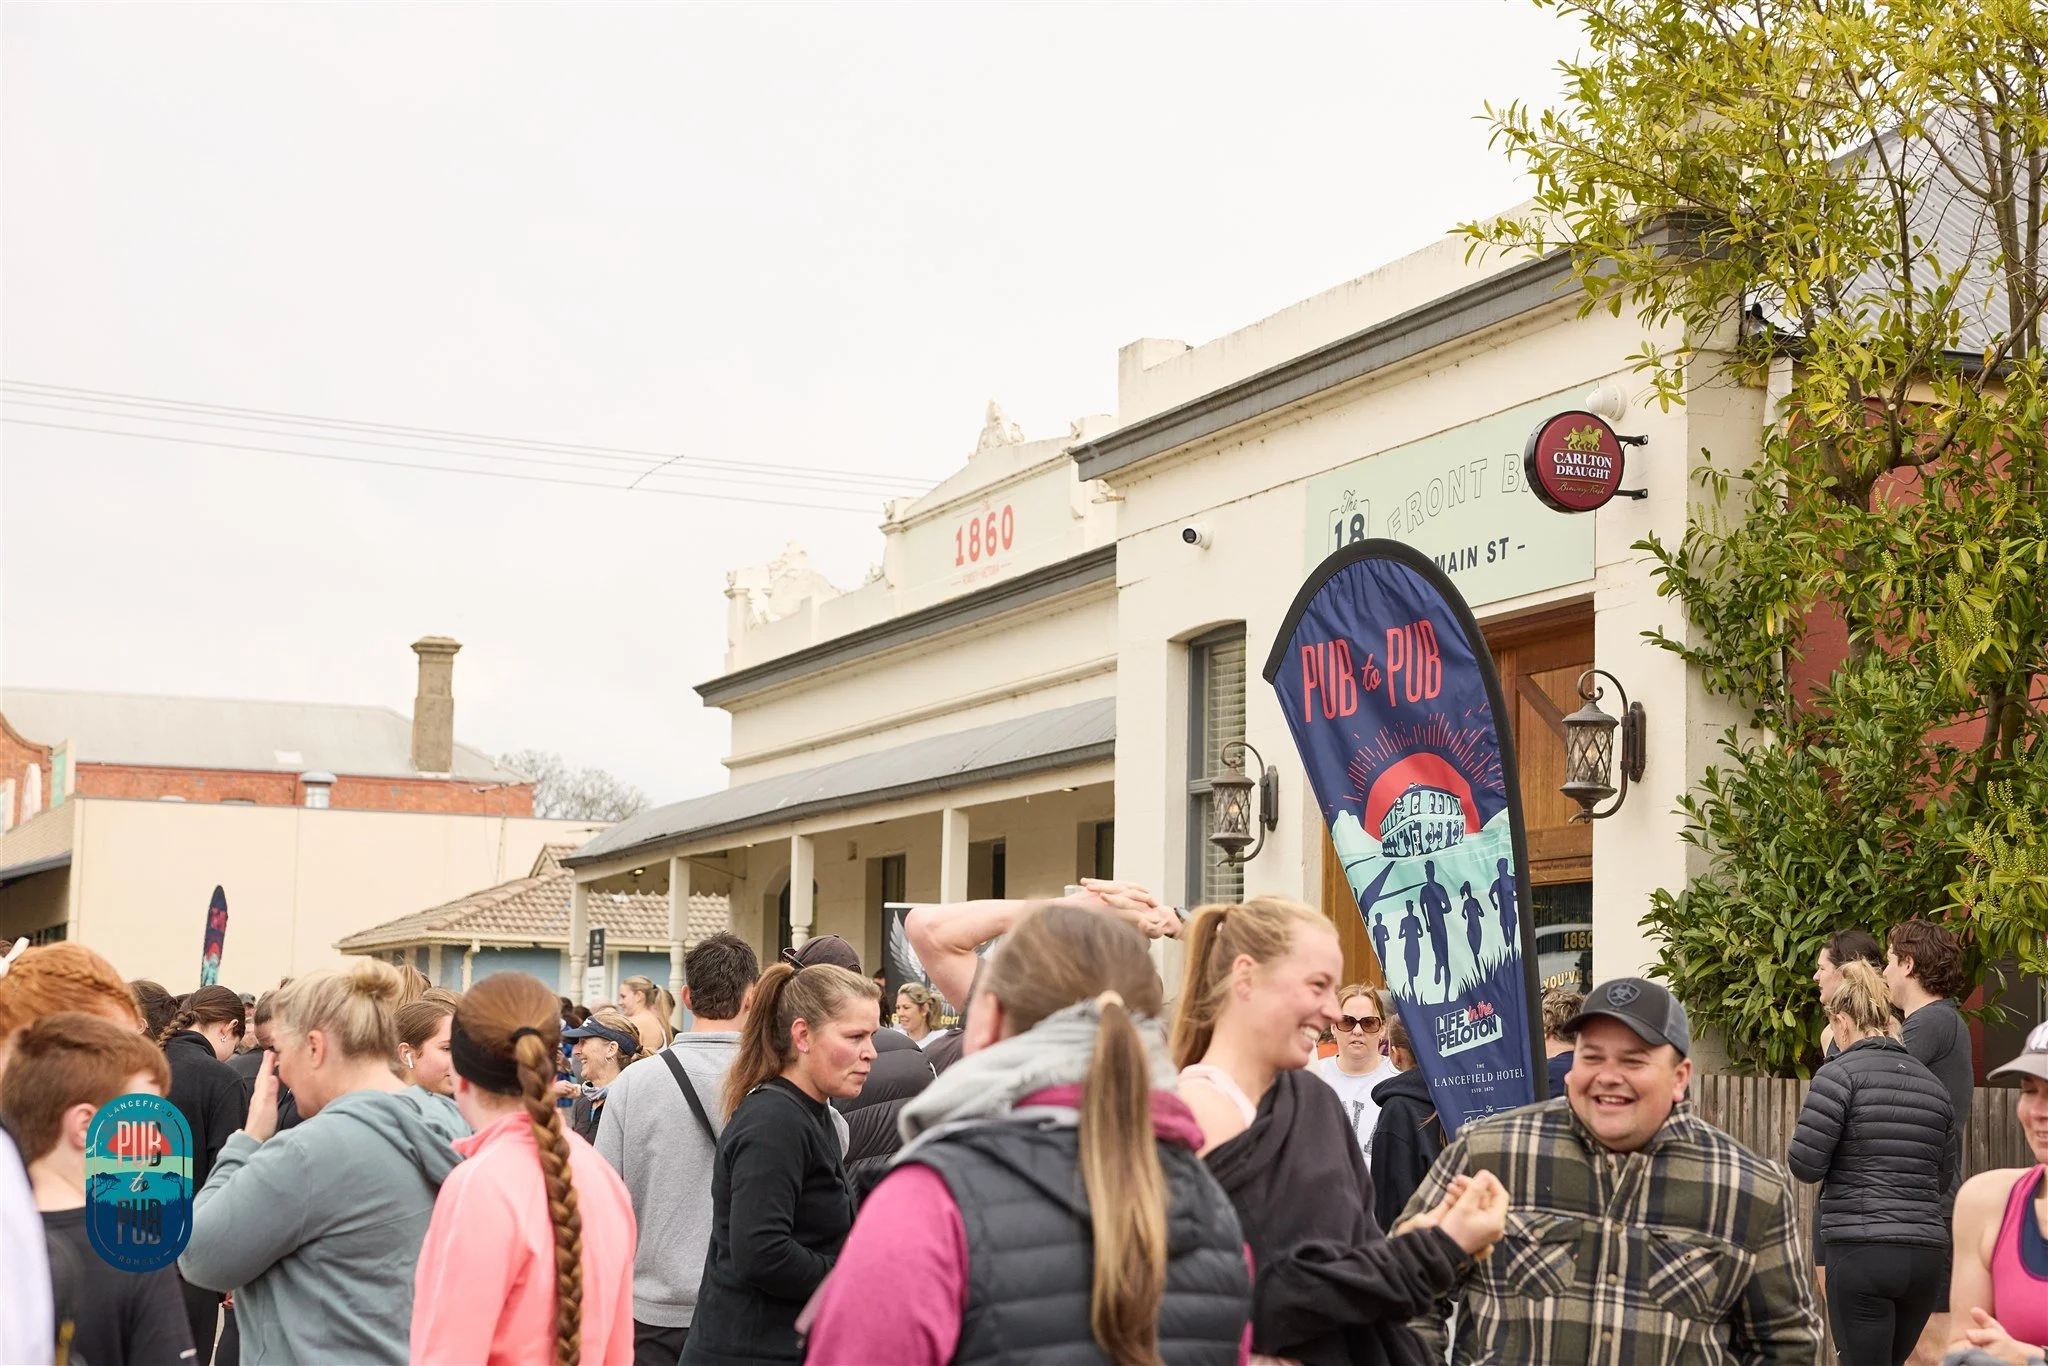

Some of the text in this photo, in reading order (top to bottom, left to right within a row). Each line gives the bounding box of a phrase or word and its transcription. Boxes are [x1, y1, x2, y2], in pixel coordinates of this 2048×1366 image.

[1553, 452, 1613, 469] CARLTON
[1556, 465, 1611, 480] DRAUGHT
[1341, 489, 1358, 514] The
[1386, 453, 1530, 541] FRONT B
[955, 504, 1014, 567] 1860
[1334, 513, 1365, 550] 18
[1486, 536, 1510, 564] ST
[1301, 619, 1442, 723] PUB to PUB
[1436, 1009, 1465, 1034] LIFE
[1477, 1000, 1494, 1018] the
[1437, 1016, 1498, 1052] PELOTON
[1434, 1068, 1525, 1088] LANCEFIELD HOTEL
